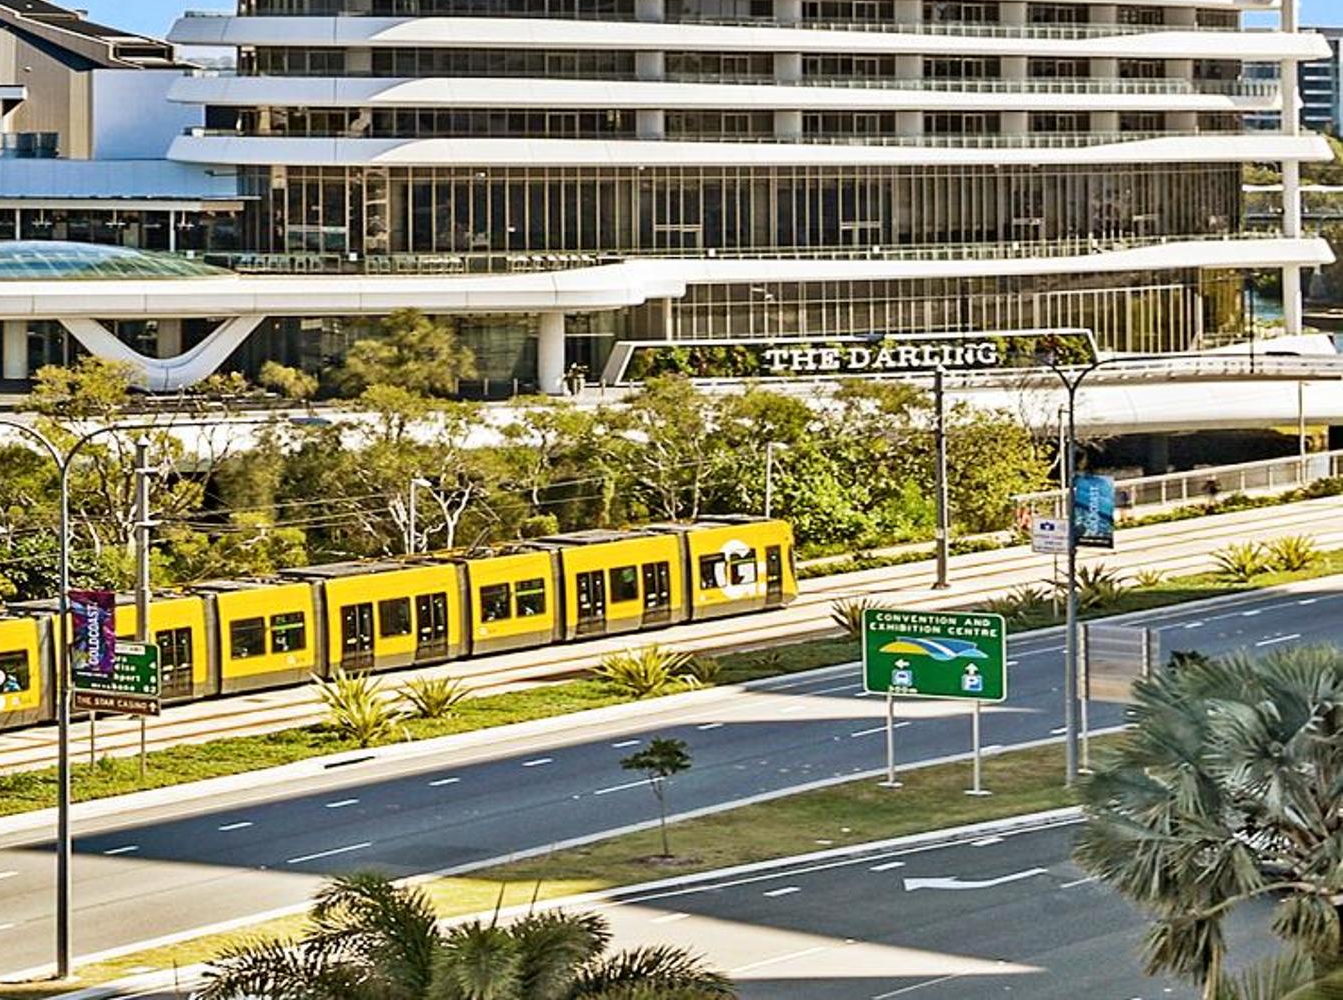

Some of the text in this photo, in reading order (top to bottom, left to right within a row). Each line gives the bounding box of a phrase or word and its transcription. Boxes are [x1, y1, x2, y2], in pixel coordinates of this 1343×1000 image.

[761, 342, 998, 371] THE DARLING
[876, 613, 991, 627] CONVENTION AND
[870, 622, 998, 638] EXHIBITION CENTRE
